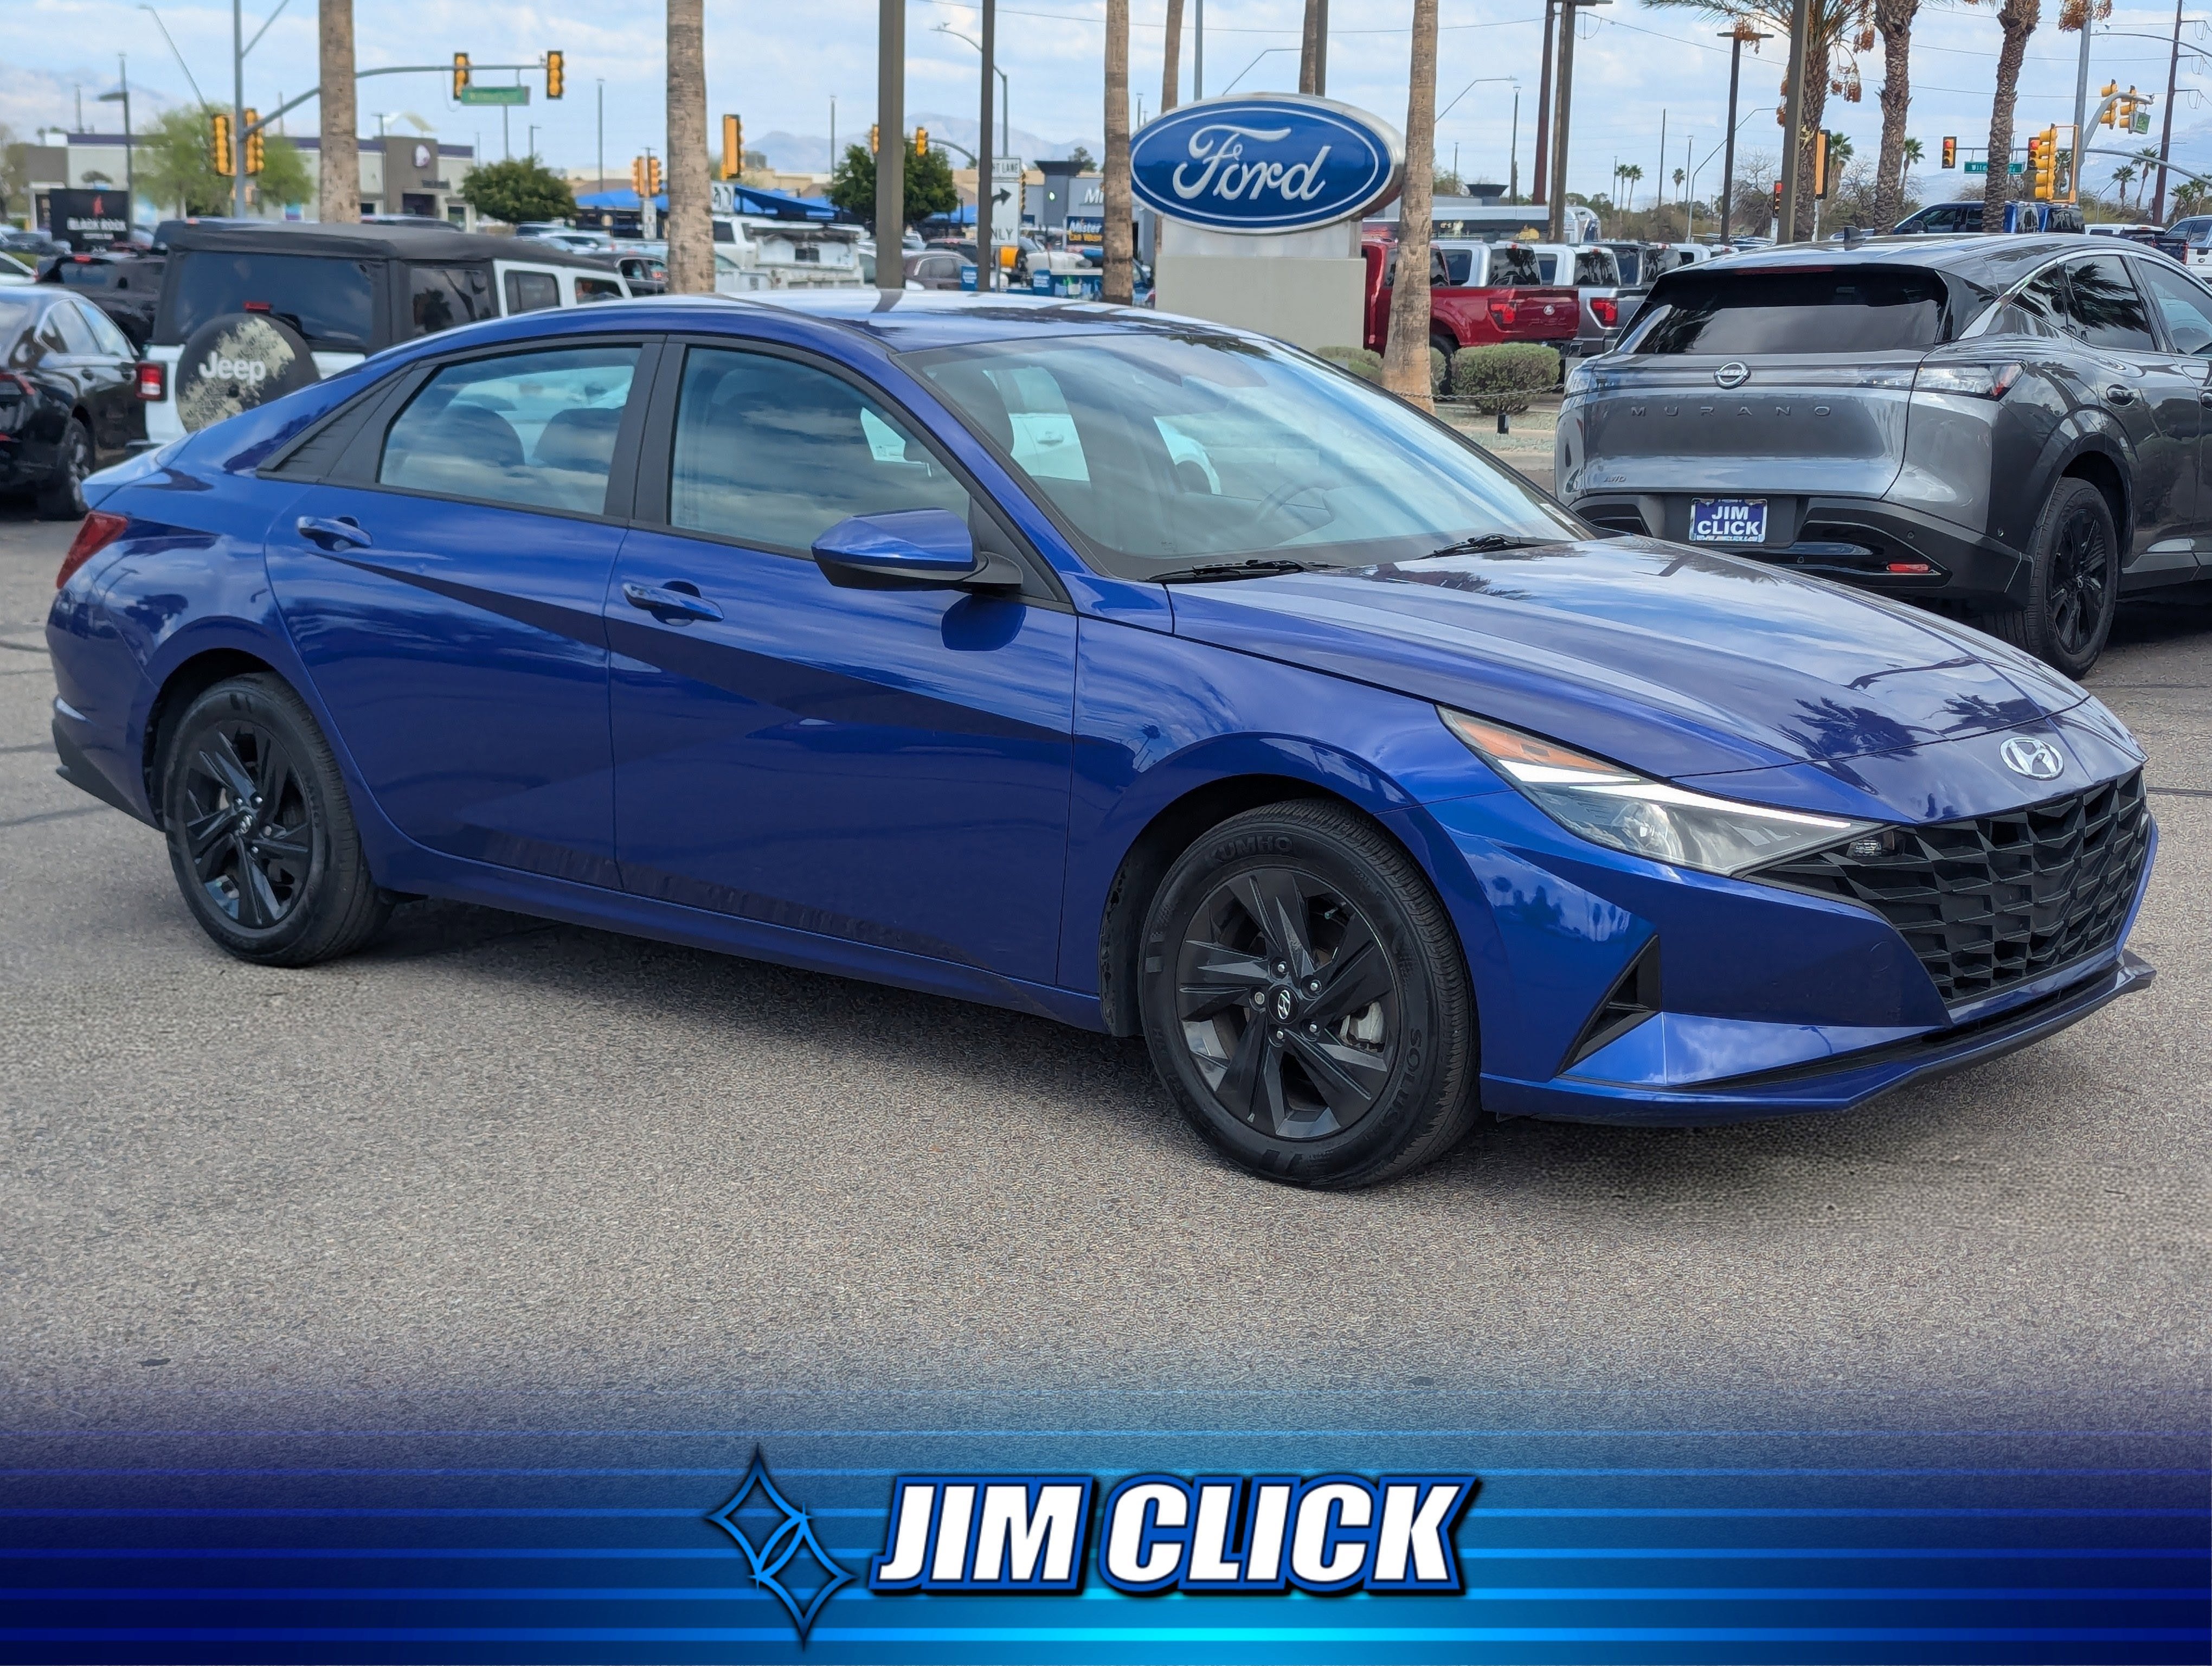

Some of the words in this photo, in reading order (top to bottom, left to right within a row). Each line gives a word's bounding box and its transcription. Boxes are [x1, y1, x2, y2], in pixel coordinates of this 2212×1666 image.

[1001, 163, 1019, 173] LANE
[1172, 124, 1332, 201] Ford
[992, 228, 1013, 240] NLY
[198, 351, 266, 386] Jeep
[1630, 406, 1832, 418] MURANO
[1711, 505, 1750, 521] JIM
[1697, 520, 1760, 535] CLICK
[1210, 833, 1294, 863] KUMHO
